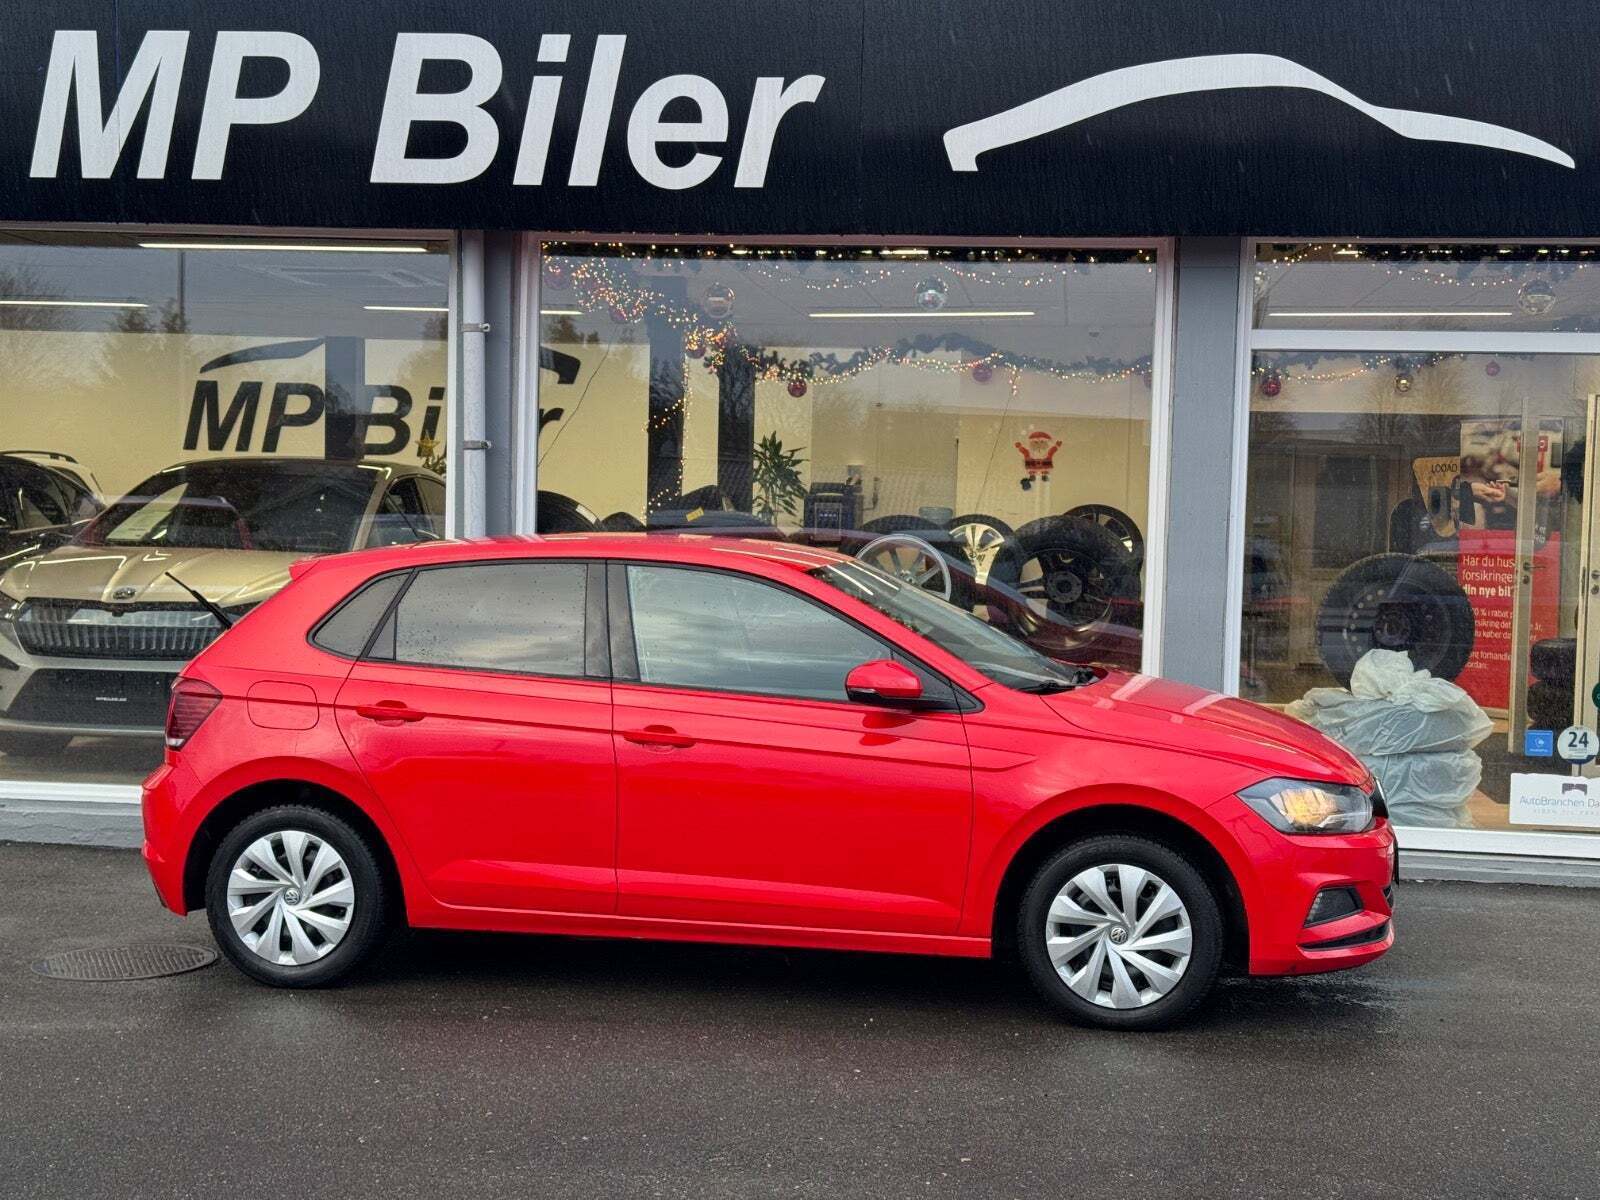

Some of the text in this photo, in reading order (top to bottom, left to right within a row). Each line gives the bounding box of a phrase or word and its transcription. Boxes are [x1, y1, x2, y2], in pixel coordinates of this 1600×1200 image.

[30, 30, 826, 190] MP Biler
[182, 379, 325, 453] MP
[1463, 555, 1515, 569] Har du hus
[1463, 569, 1512, 584] forsikringe
[1479, 586, 1496, 598] nye
[1568, 731, 1589, 748] 24
[1520, 796, 1600, 809] AutoBranchen Da
